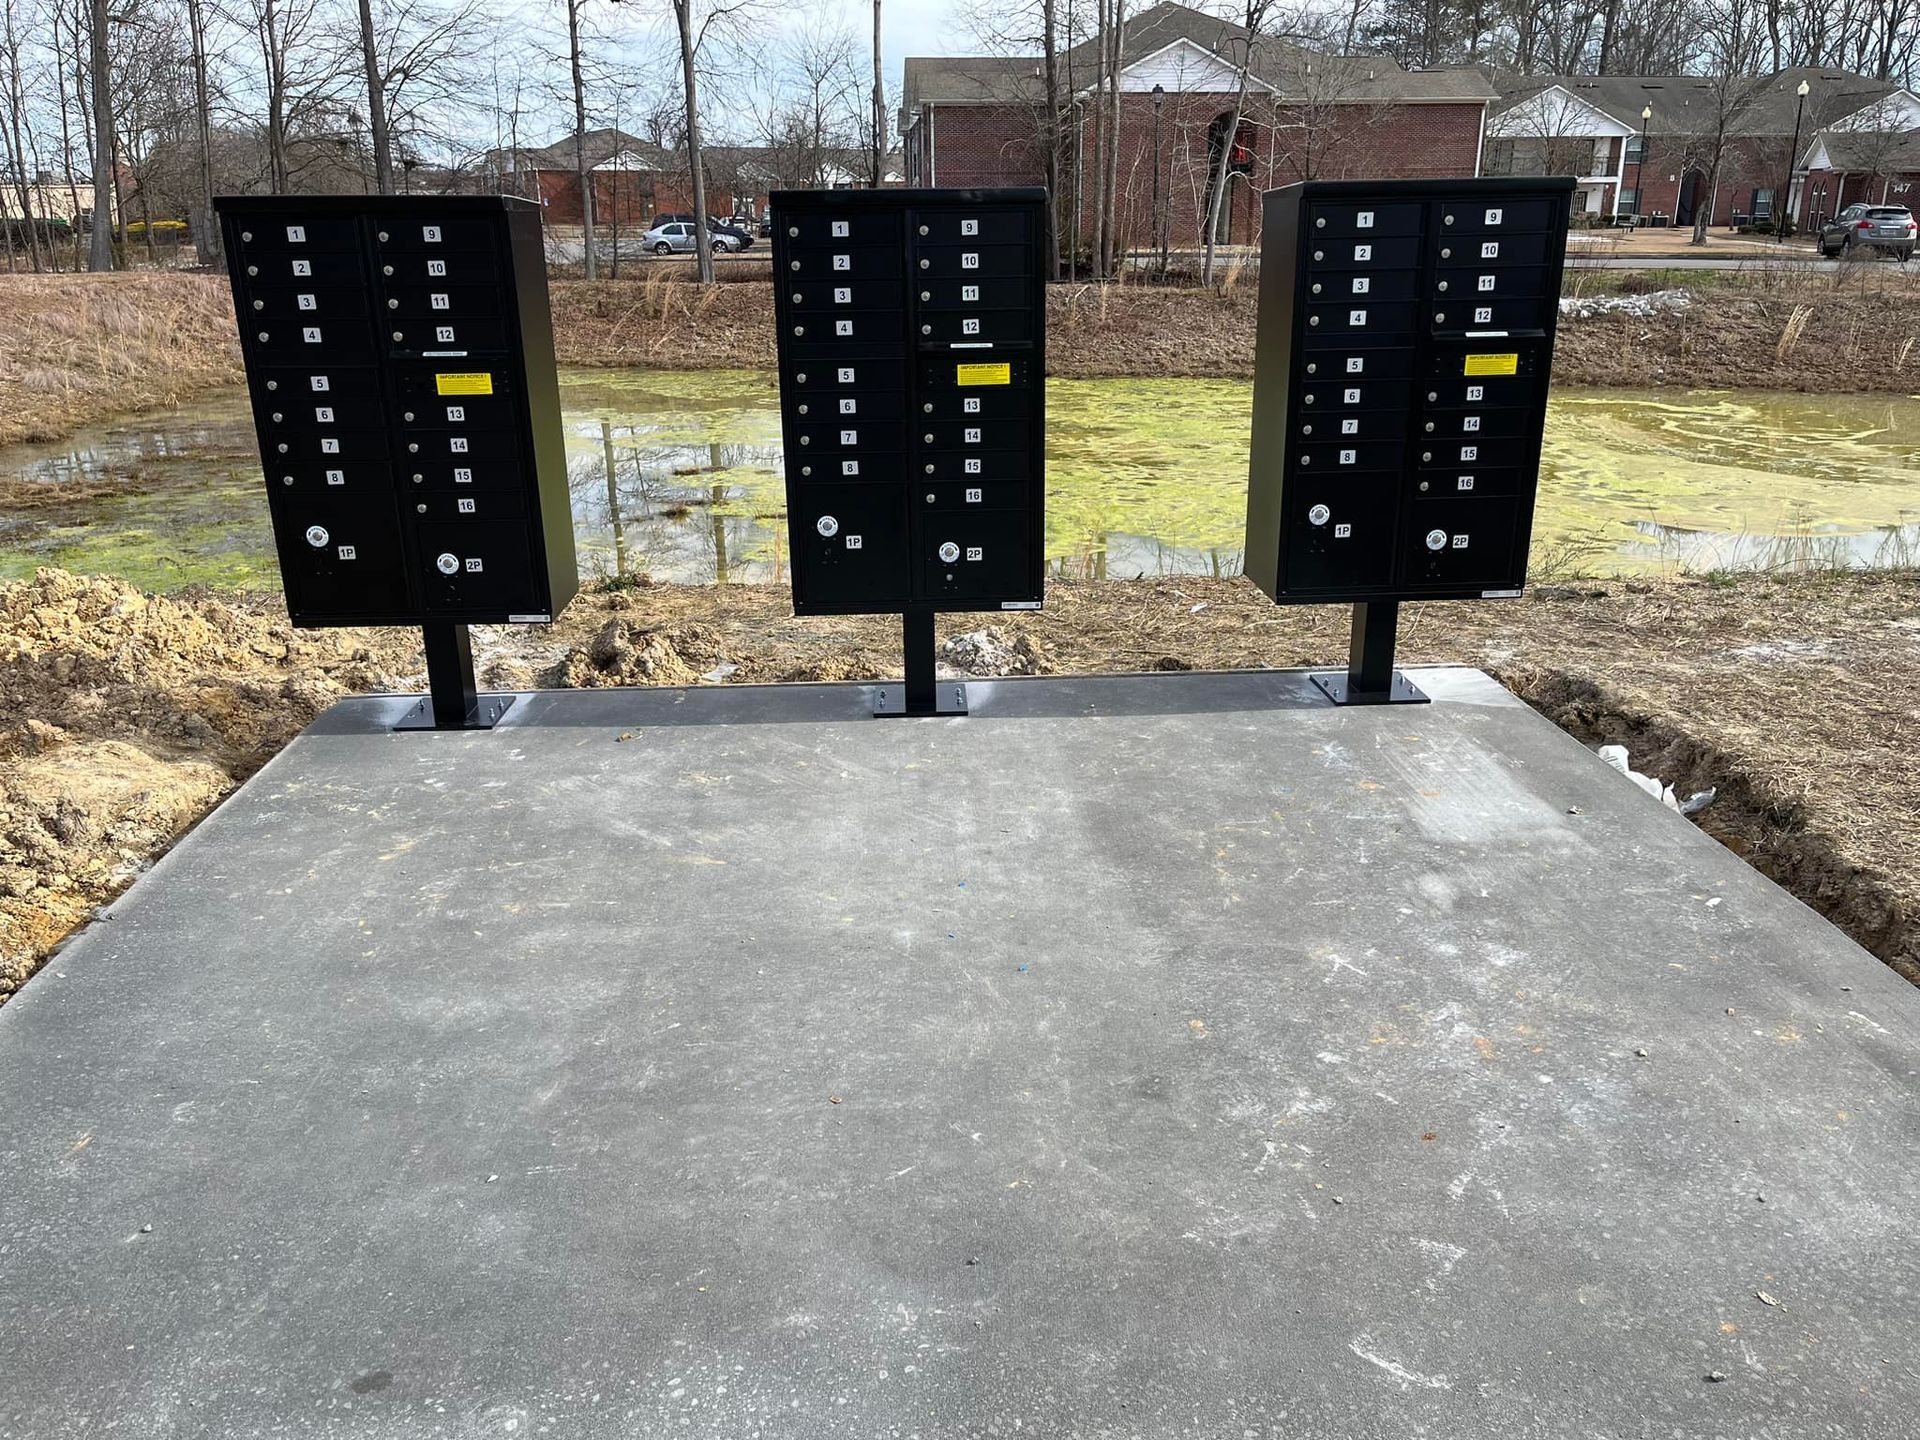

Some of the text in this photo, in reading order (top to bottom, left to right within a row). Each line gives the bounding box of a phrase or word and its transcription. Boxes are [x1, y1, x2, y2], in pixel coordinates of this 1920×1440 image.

[1484, 245, 1497, 256] 10
[964, 255, 977, 266] 10
[430, 263, 444, 274] 10
[1481, 278, 1493, 289] 11
[964, 288, 976, 299] 11
[433, 296, 446, 307] 11
[1477, 310, 1490, 321] 12
[964, 321, 978, 332] 12
[439, 329, 453, 340] 12
[1469, 388, 1481, 399] 13
[966, 400, 979, 411] 13
[449, 409, 463, 419] 13
[1467, 419, 1478, 429] 14
[967, 430, 979, 441] 14
[452, 440, 466, 451] 14
[1463, 449, 1475, 459] 15
[967, 461, 979, 471] 15
[456, 470, 470, 481] 15
[1460, 478, 1472, 488] 16
[967, 490, 980, 501] 16
[460, 501, 473, 511] 16
[1337, 526, 1350, 536] 1P
[847, 537, 861, 547] 1P
[1454, 537, 1467, 547] 2P
[340, 548, 354, 558] 1P
[968, 549, 981, 559] 2P
[467, 560, 481, 570] 2P
